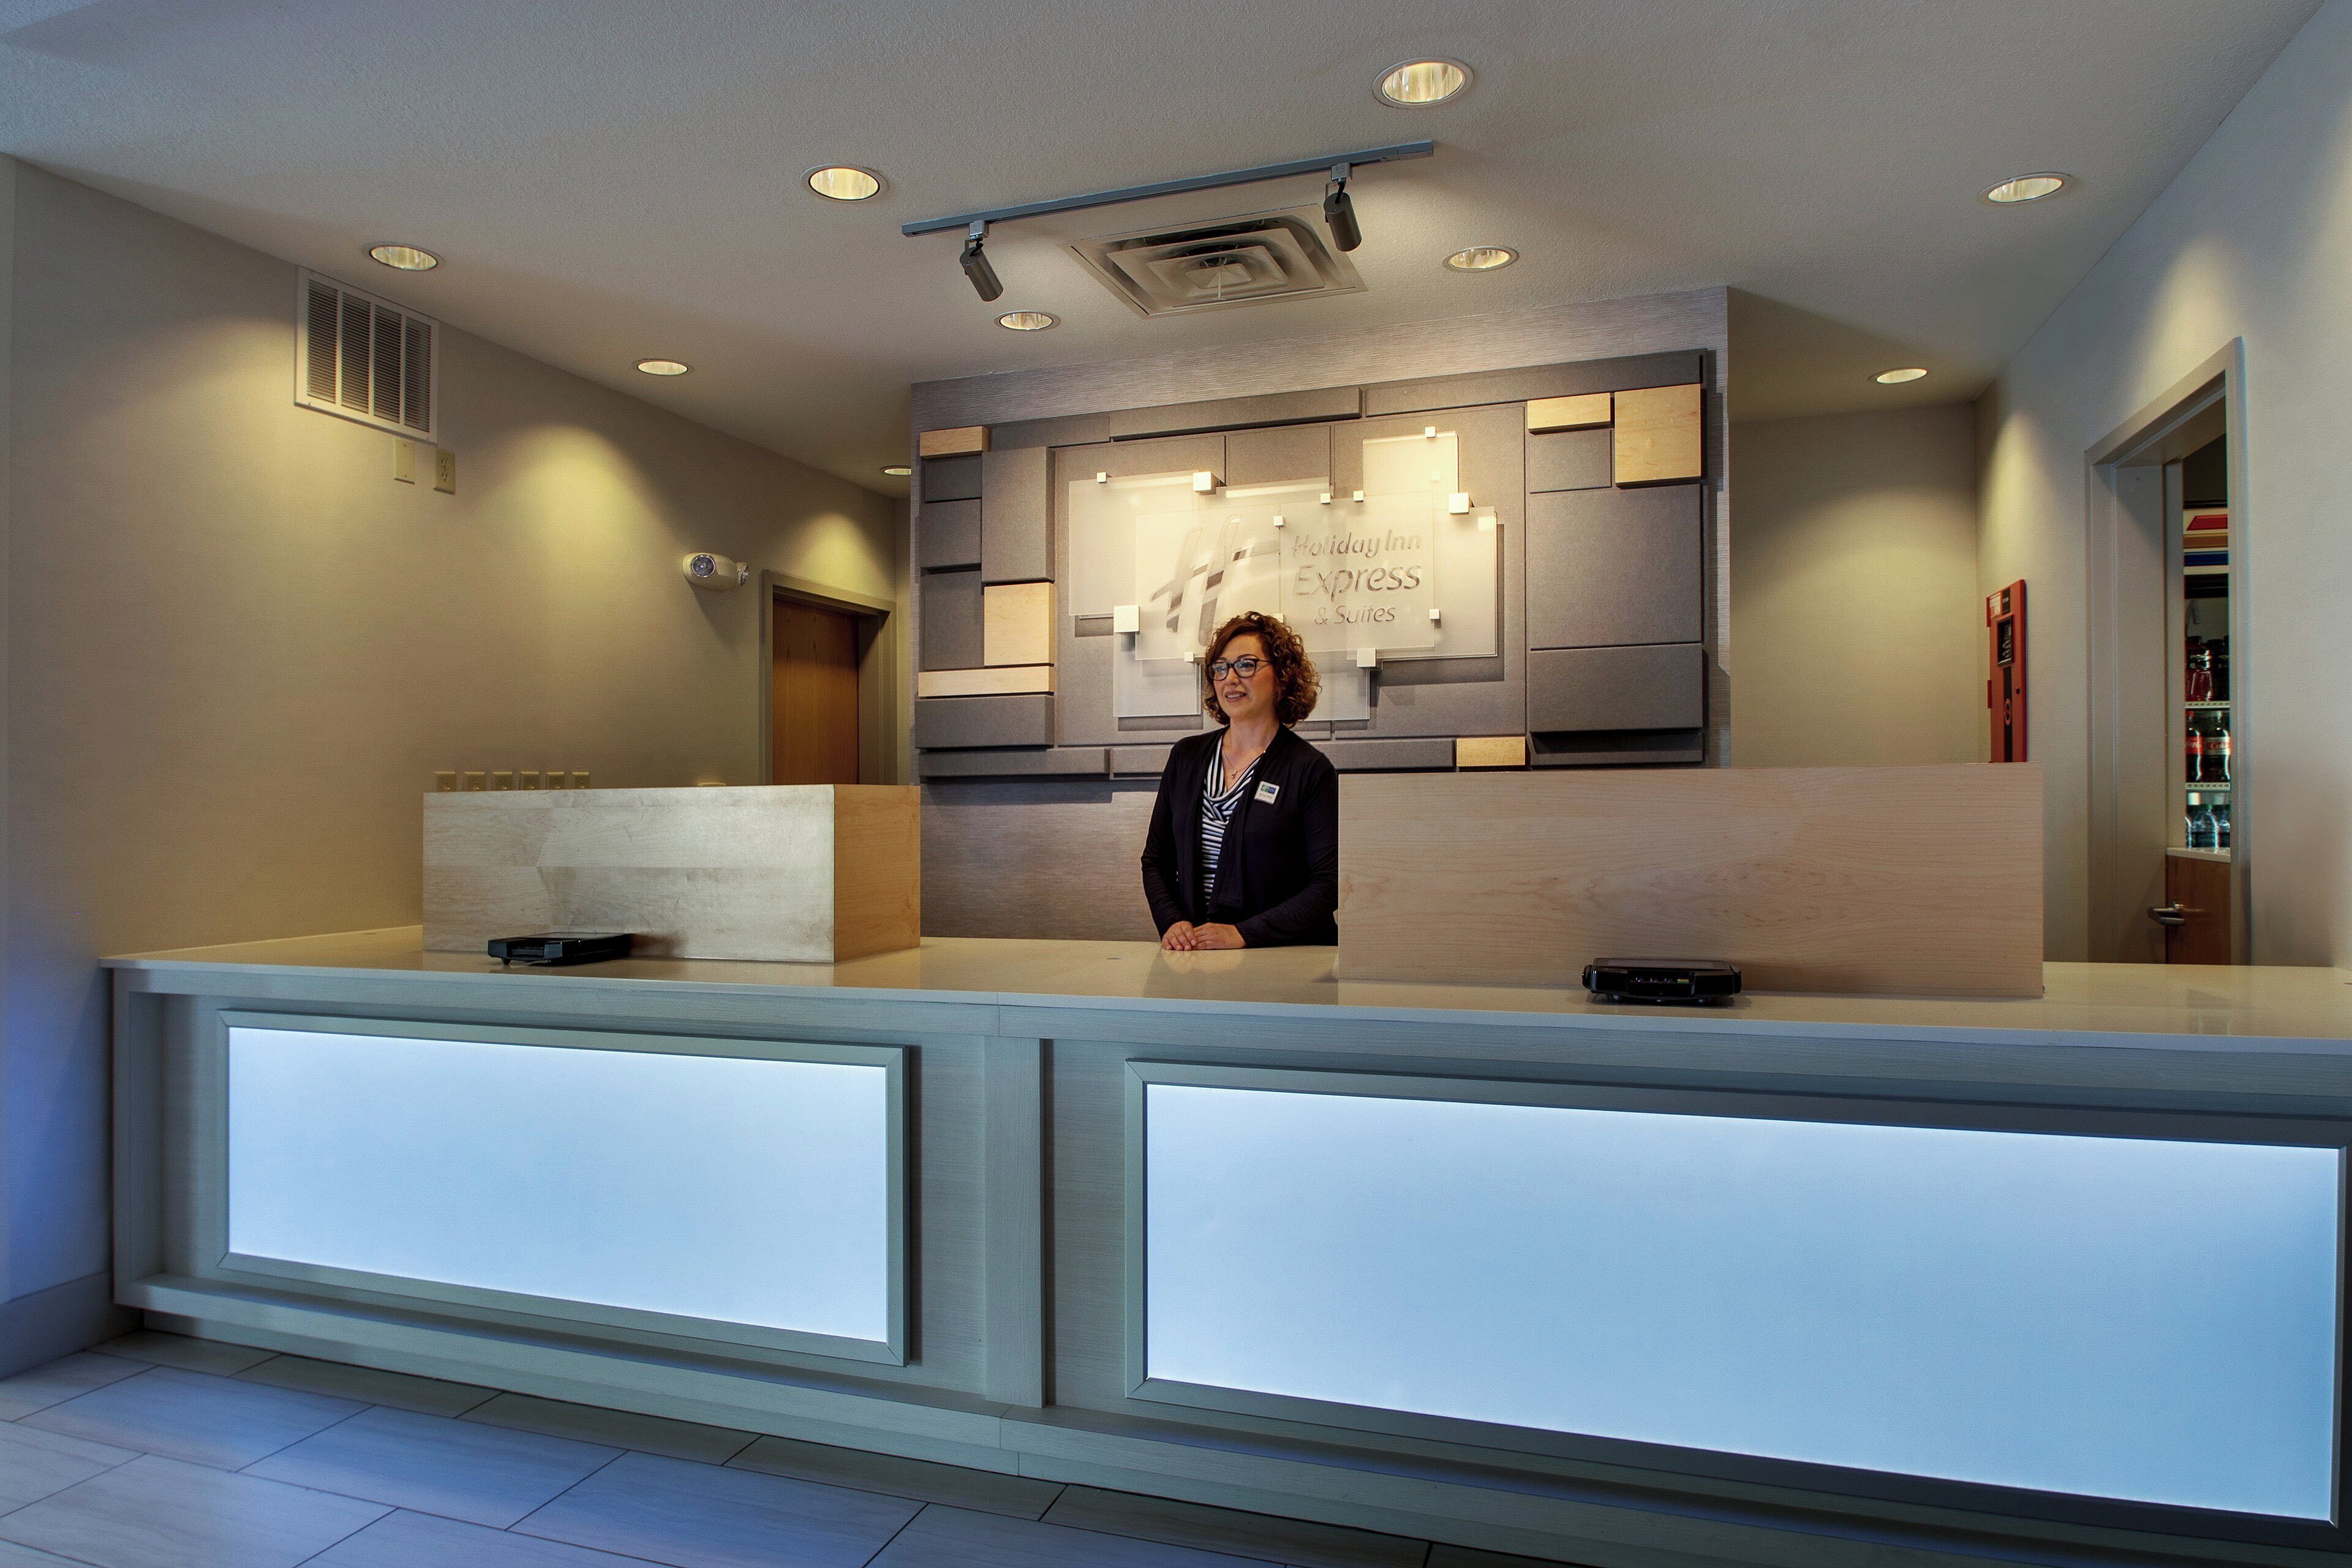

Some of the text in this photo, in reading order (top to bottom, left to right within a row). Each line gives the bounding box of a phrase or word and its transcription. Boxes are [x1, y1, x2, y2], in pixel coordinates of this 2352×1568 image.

[1292, 529, 1421, 559] Holiday Inn
[1293, 564, 1421, 602] Express
[1314, 605, 1396, 625] & Suites
